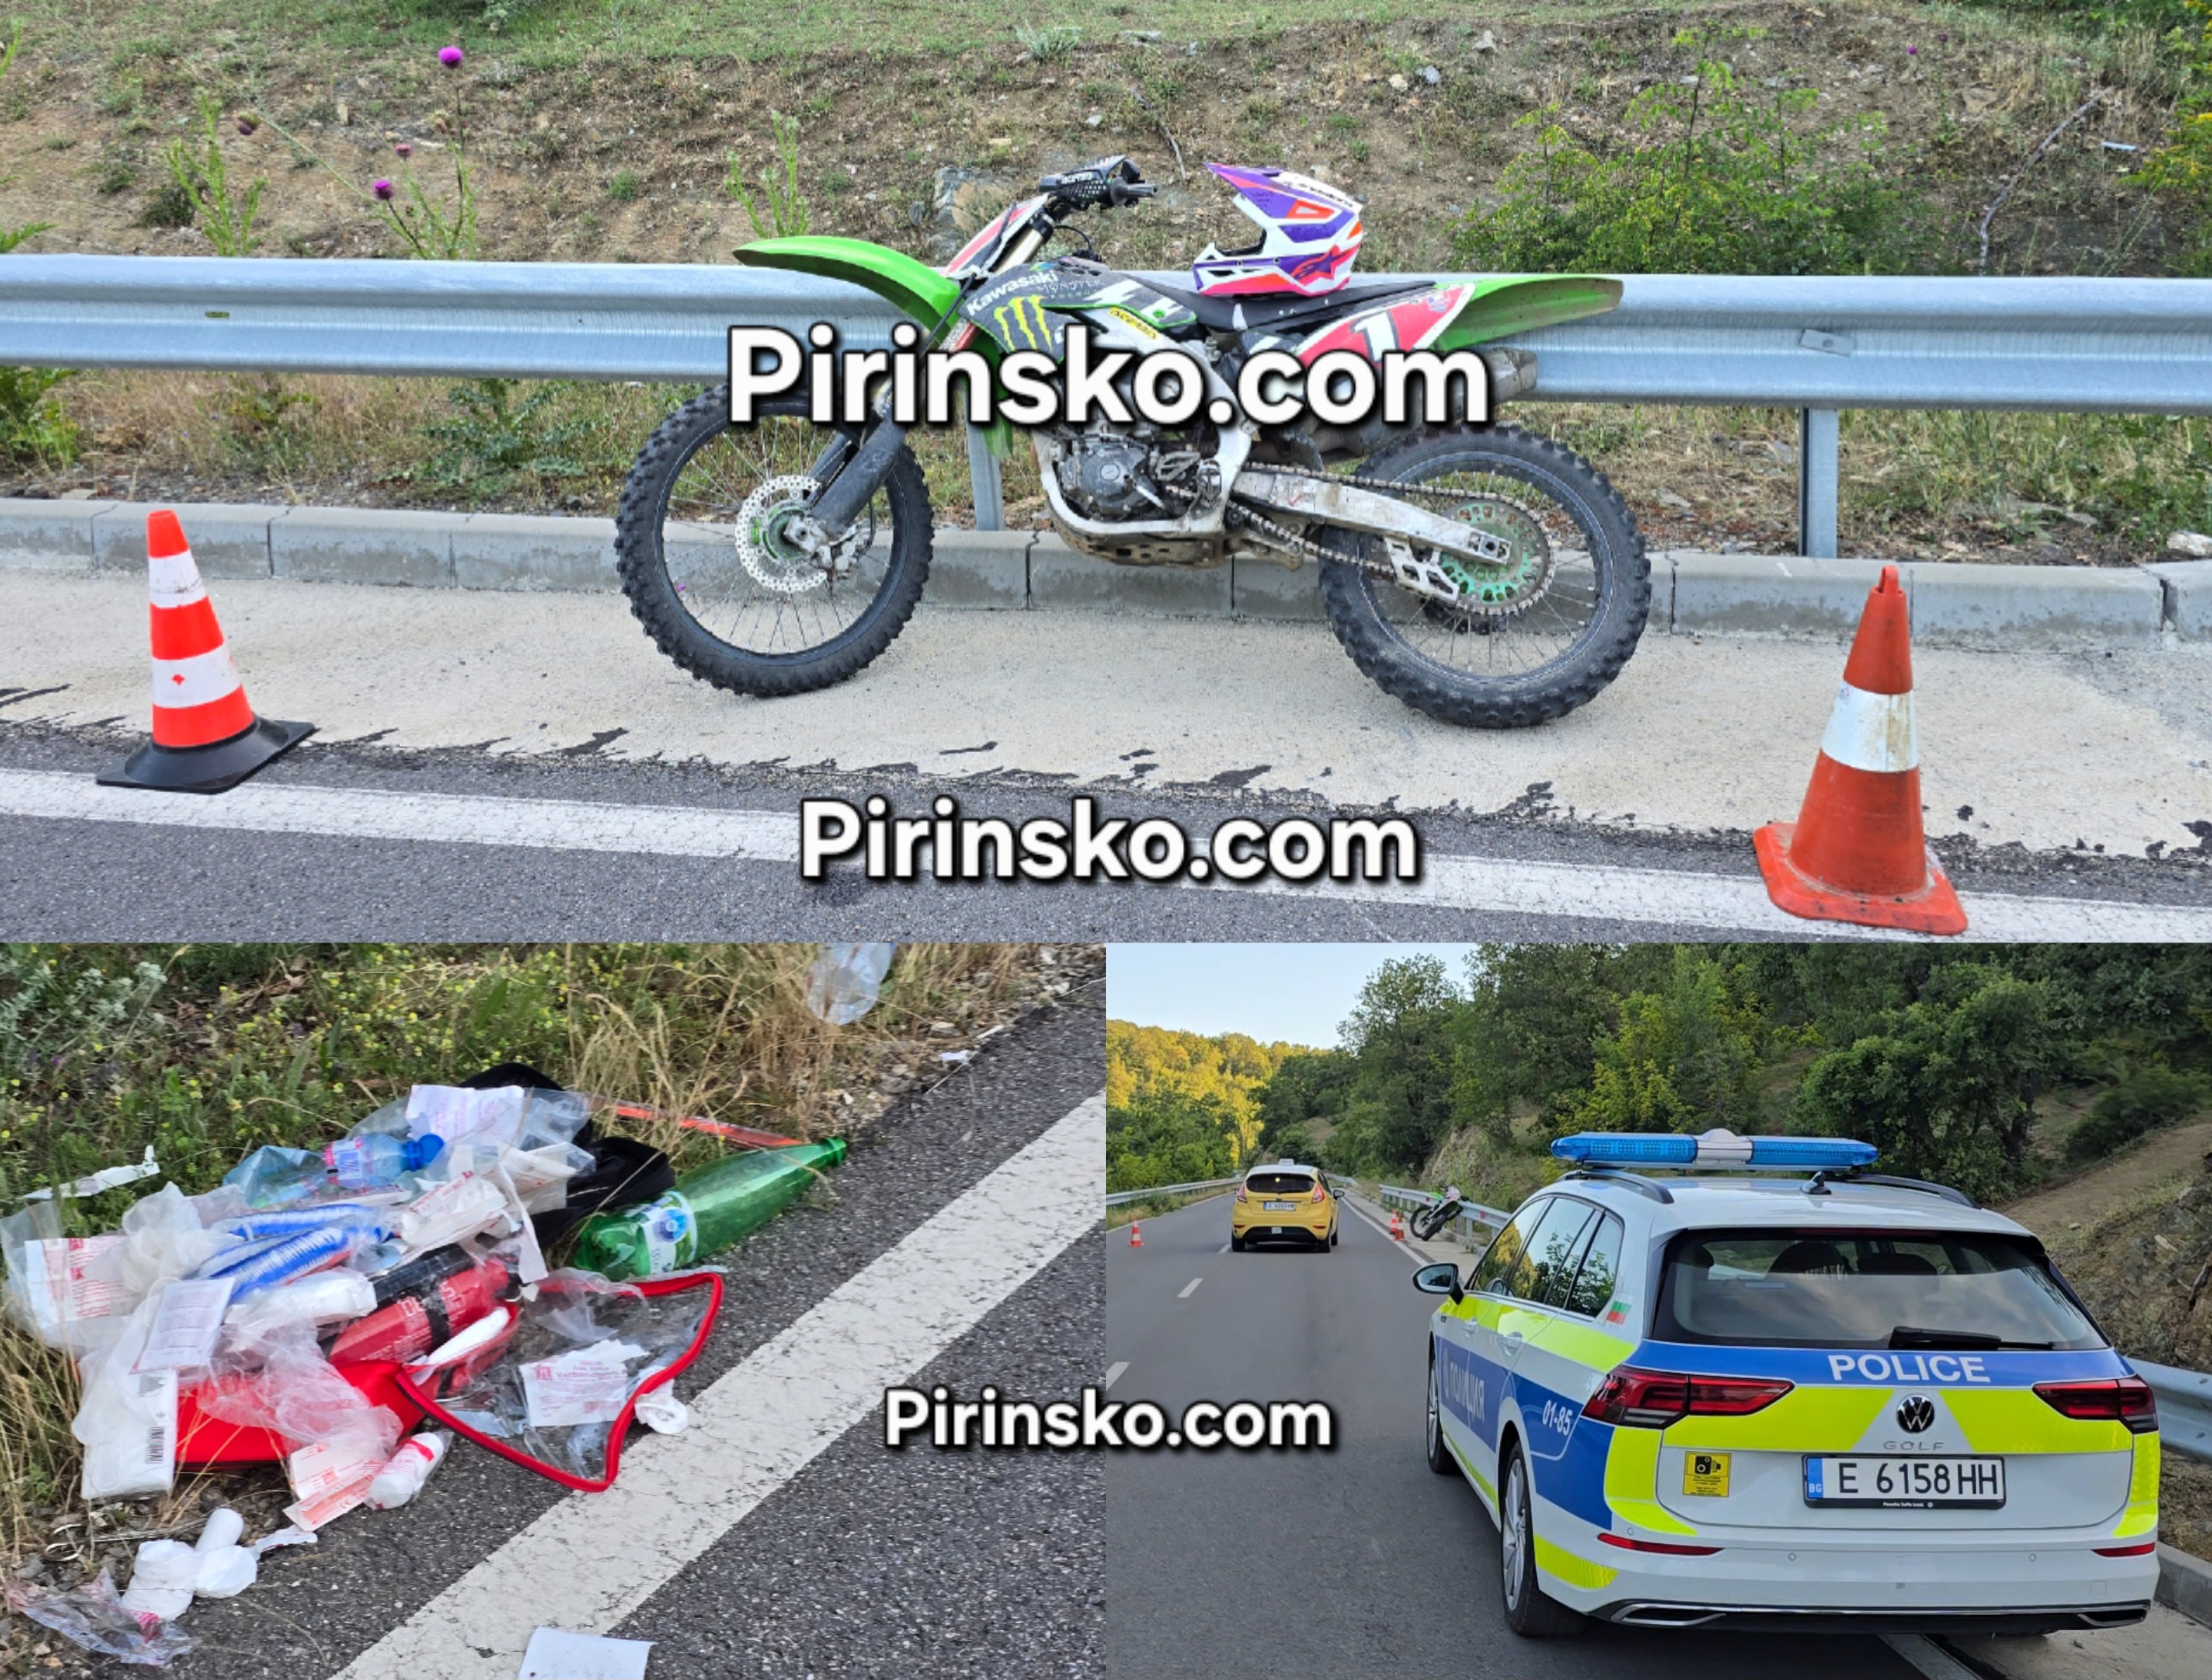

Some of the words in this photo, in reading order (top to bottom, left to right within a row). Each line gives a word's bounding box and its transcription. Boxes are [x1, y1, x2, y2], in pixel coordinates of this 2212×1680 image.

[966, 270, 1058, 316] Kawasaki
[1350, 309, 1399, 363] 1
[1827, 1354, 1991, 1383] POLICE
[1542, 1400, 1573, 1436] 01-85
[1883, 1441, 1945, 1451] GOLF
[1808, 1483, 1823, 1493] BG
[1839, 1463, 1859, 1493] E
[1876, 1463, 1951, 1494] 6158
